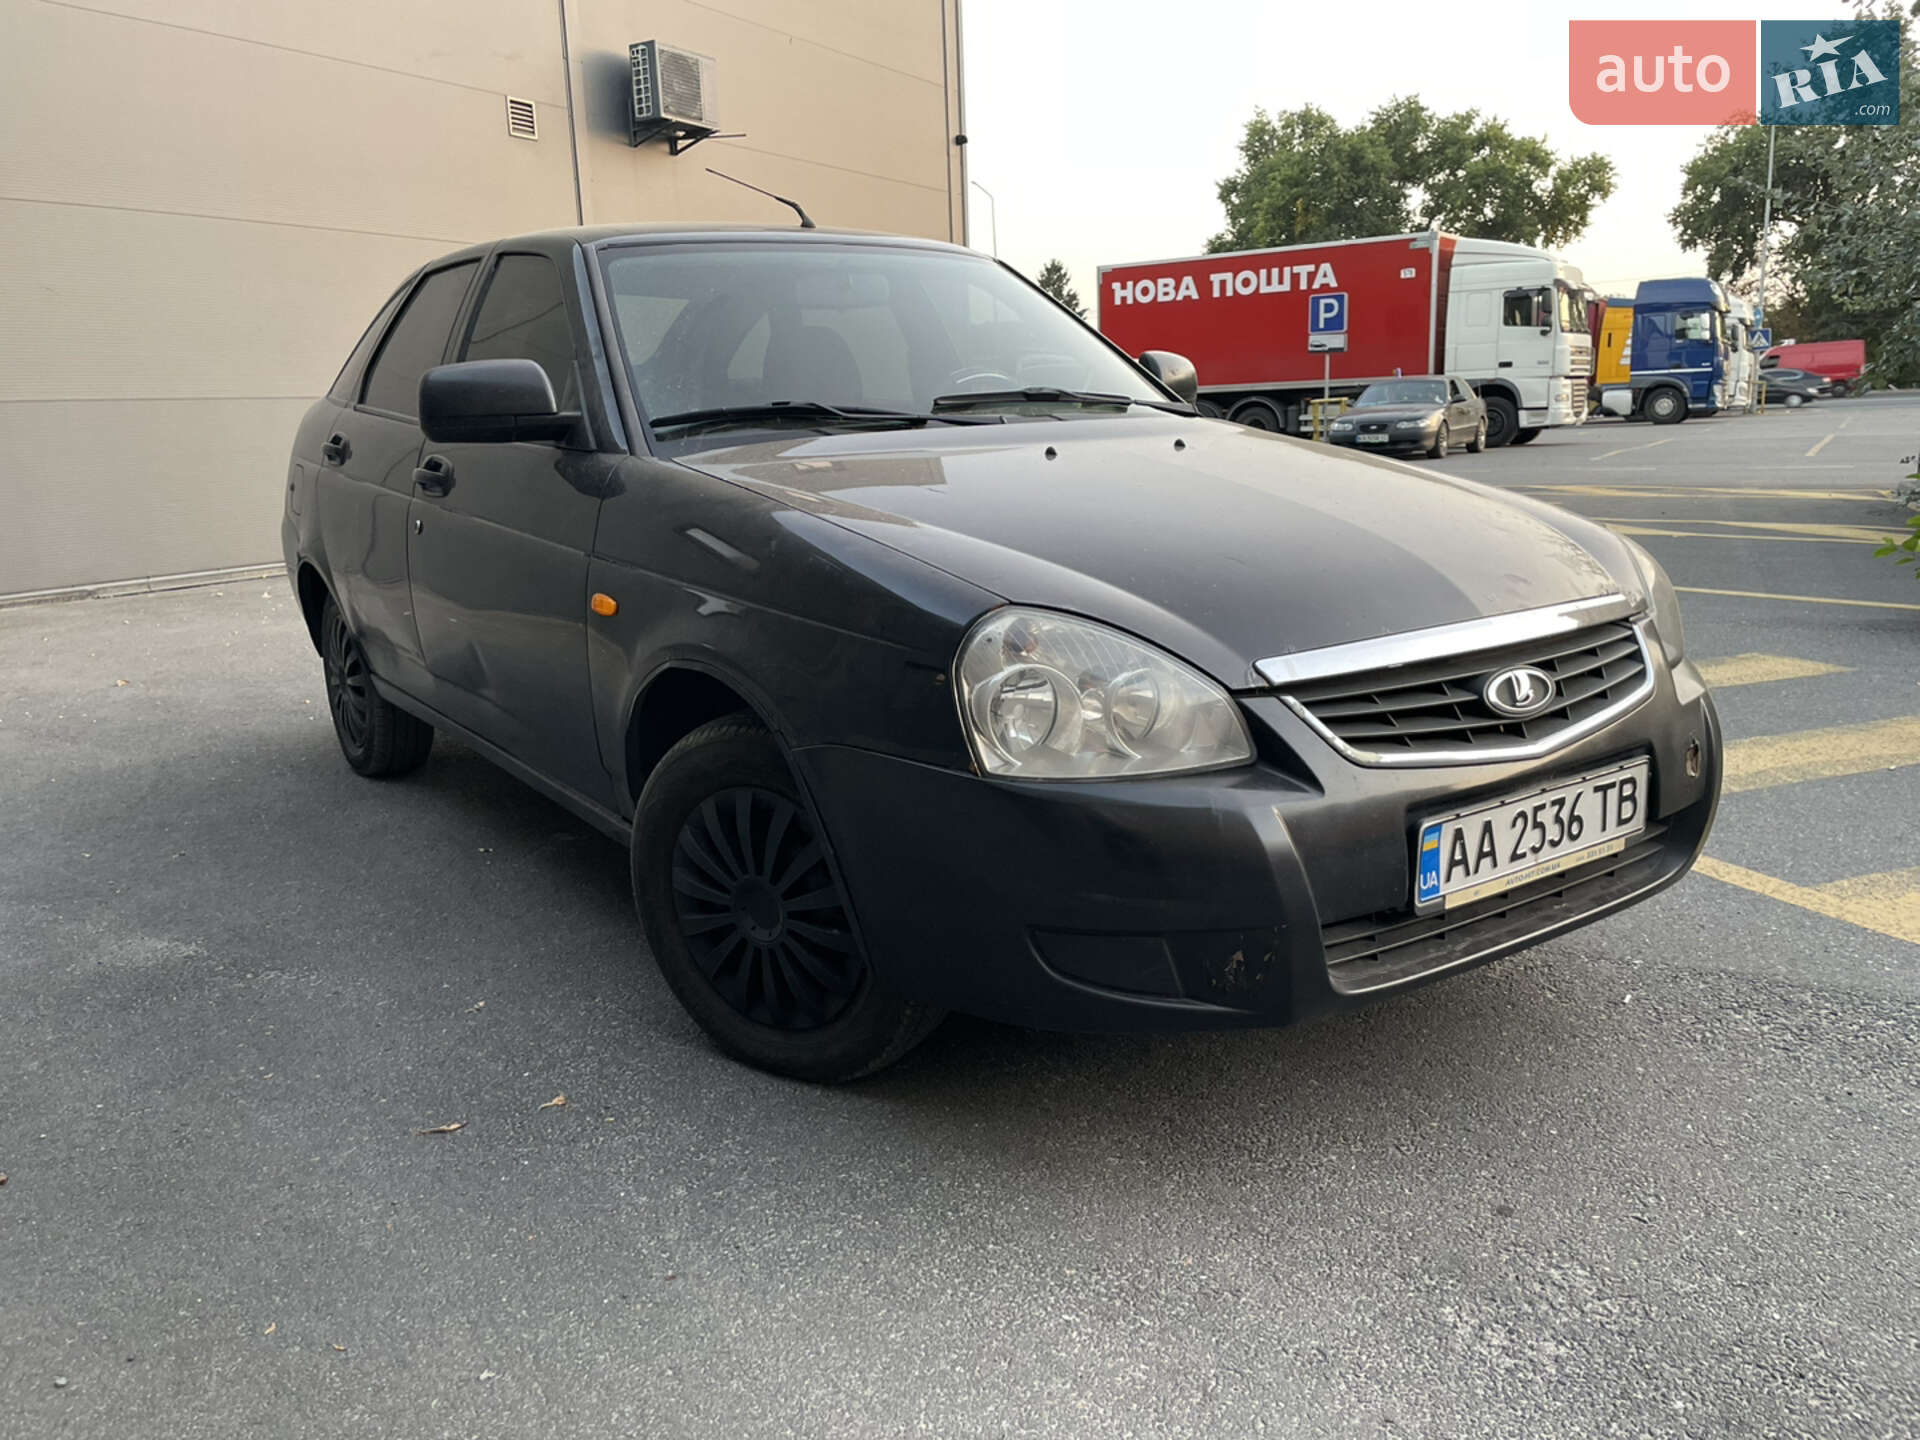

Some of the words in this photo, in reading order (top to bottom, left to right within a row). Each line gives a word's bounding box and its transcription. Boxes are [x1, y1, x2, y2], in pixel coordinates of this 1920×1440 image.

[1111, 276, 1200, 306] НОВА
[1209, 262, 1339, 299] ПОШТА
[1318, 298, 1340, 329] P
[1445, 819, 1499, 884] AA
[1508, 790, 1585, 863] 2536
[1592, 774, 1639, 833] TB
[1420, 870, 1439, 891] UA
